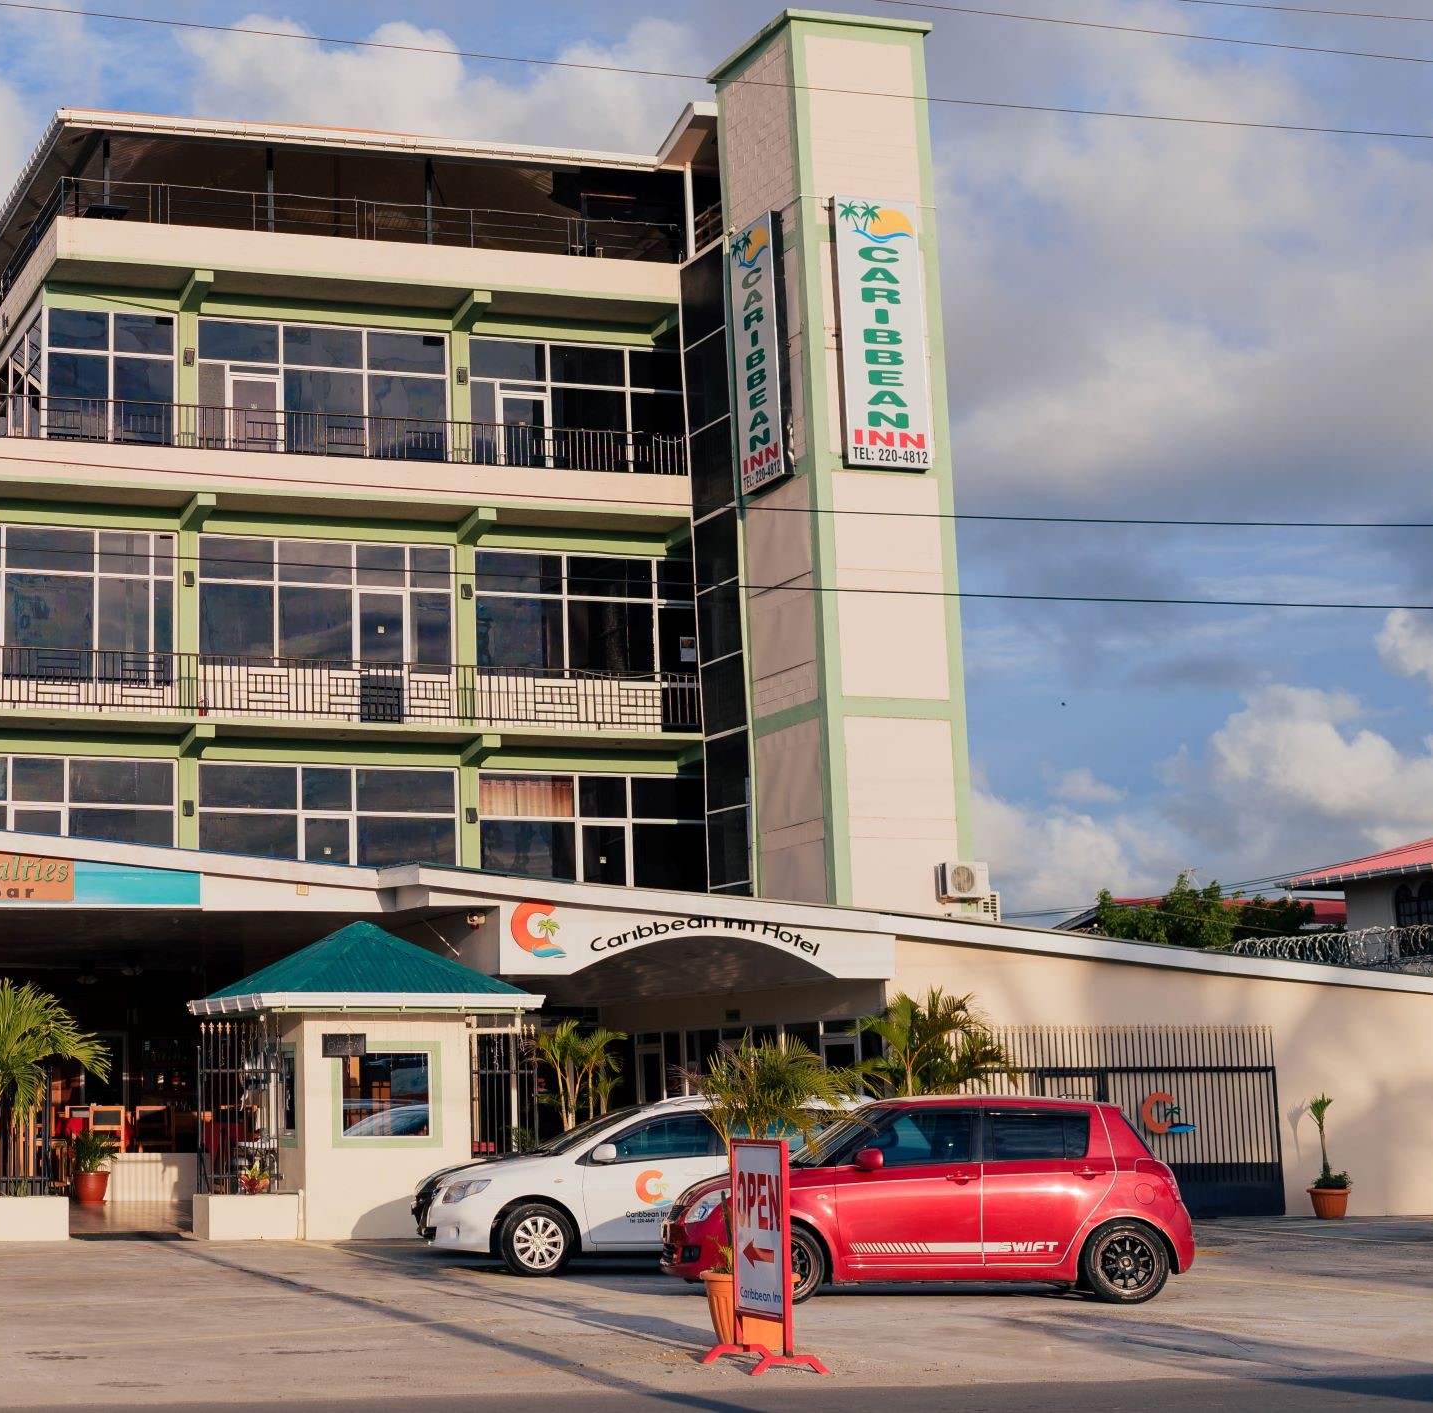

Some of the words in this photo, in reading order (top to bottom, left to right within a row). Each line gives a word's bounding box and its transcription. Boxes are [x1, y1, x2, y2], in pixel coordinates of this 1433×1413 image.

[857, 246, 910, 430] CARIBBEAN
[741, 267, 772, 453] CARIBBEAN
[854, 429, 926, 449] INN
[743, 441, 779, 475] INN
[852, 446, 875, 461] TEL:
[878, 448, 929, 464] 220-4812
[743, 476, 755, 491] TEL:
[755, 461, 781, 483] 220-4812
[590, 916, 717, 952] Caribbean
[762, 921, 820, 956] Hotel
[625, 1210, 660, 1218] Caribbean
[737, 1170, 781, 1232] OPEN
[999, 1241, 1059, 1252] SWIFT
[739, 1286, 772, 1304] Caribbean
